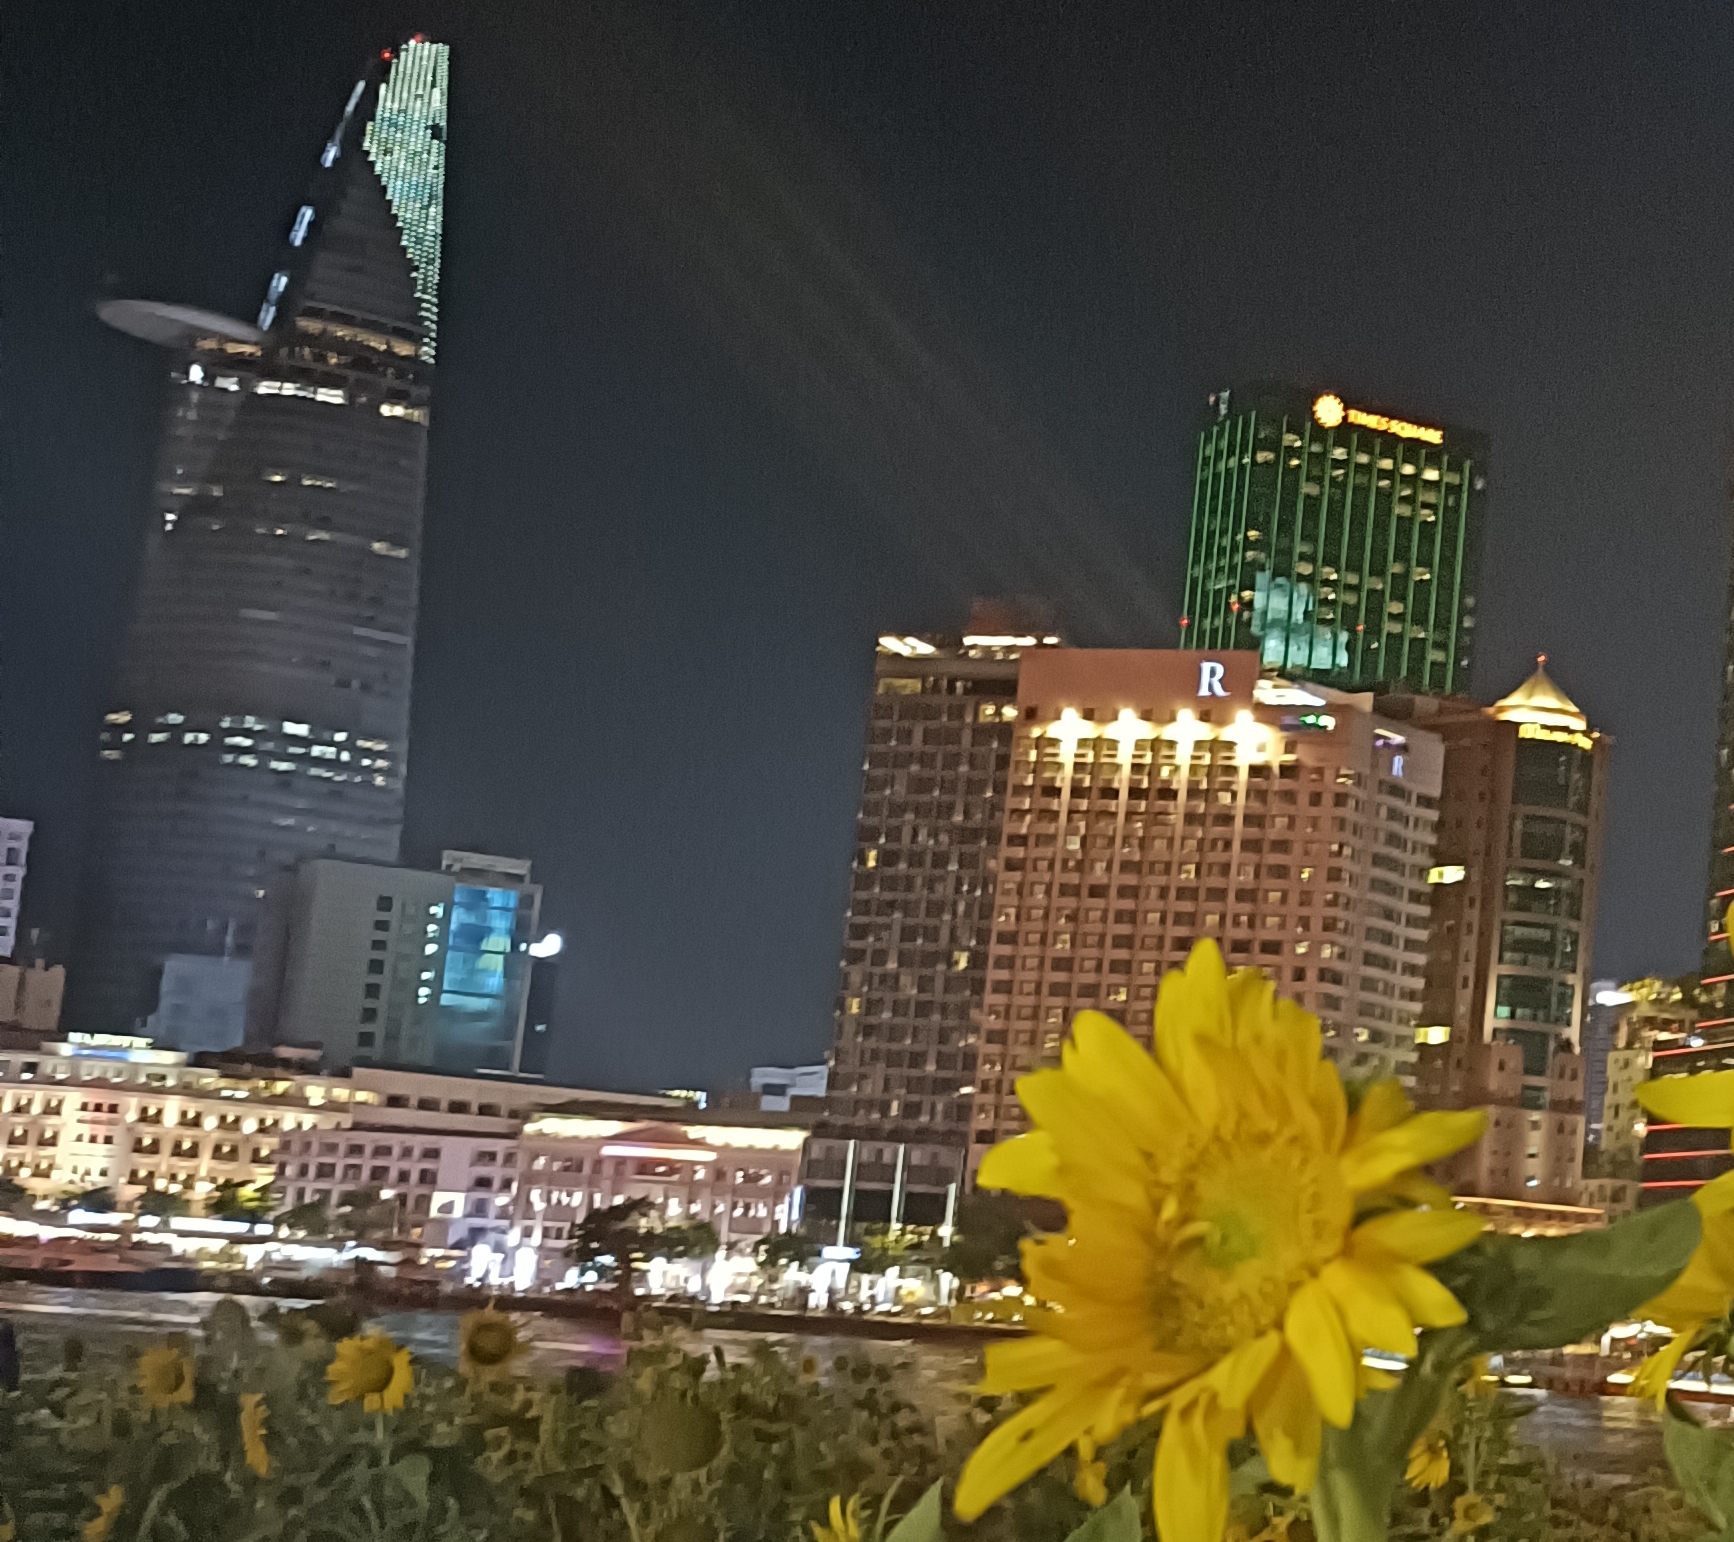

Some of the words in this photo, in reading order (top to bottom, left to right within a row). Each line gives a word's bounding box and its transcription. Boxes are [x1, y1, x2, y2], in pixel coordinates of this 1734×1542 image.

[1346, 409, 1390, 431] TIMES
[1387, 419, 1444, 445] SQUARE
[1196, 660, 1232, 697] R
